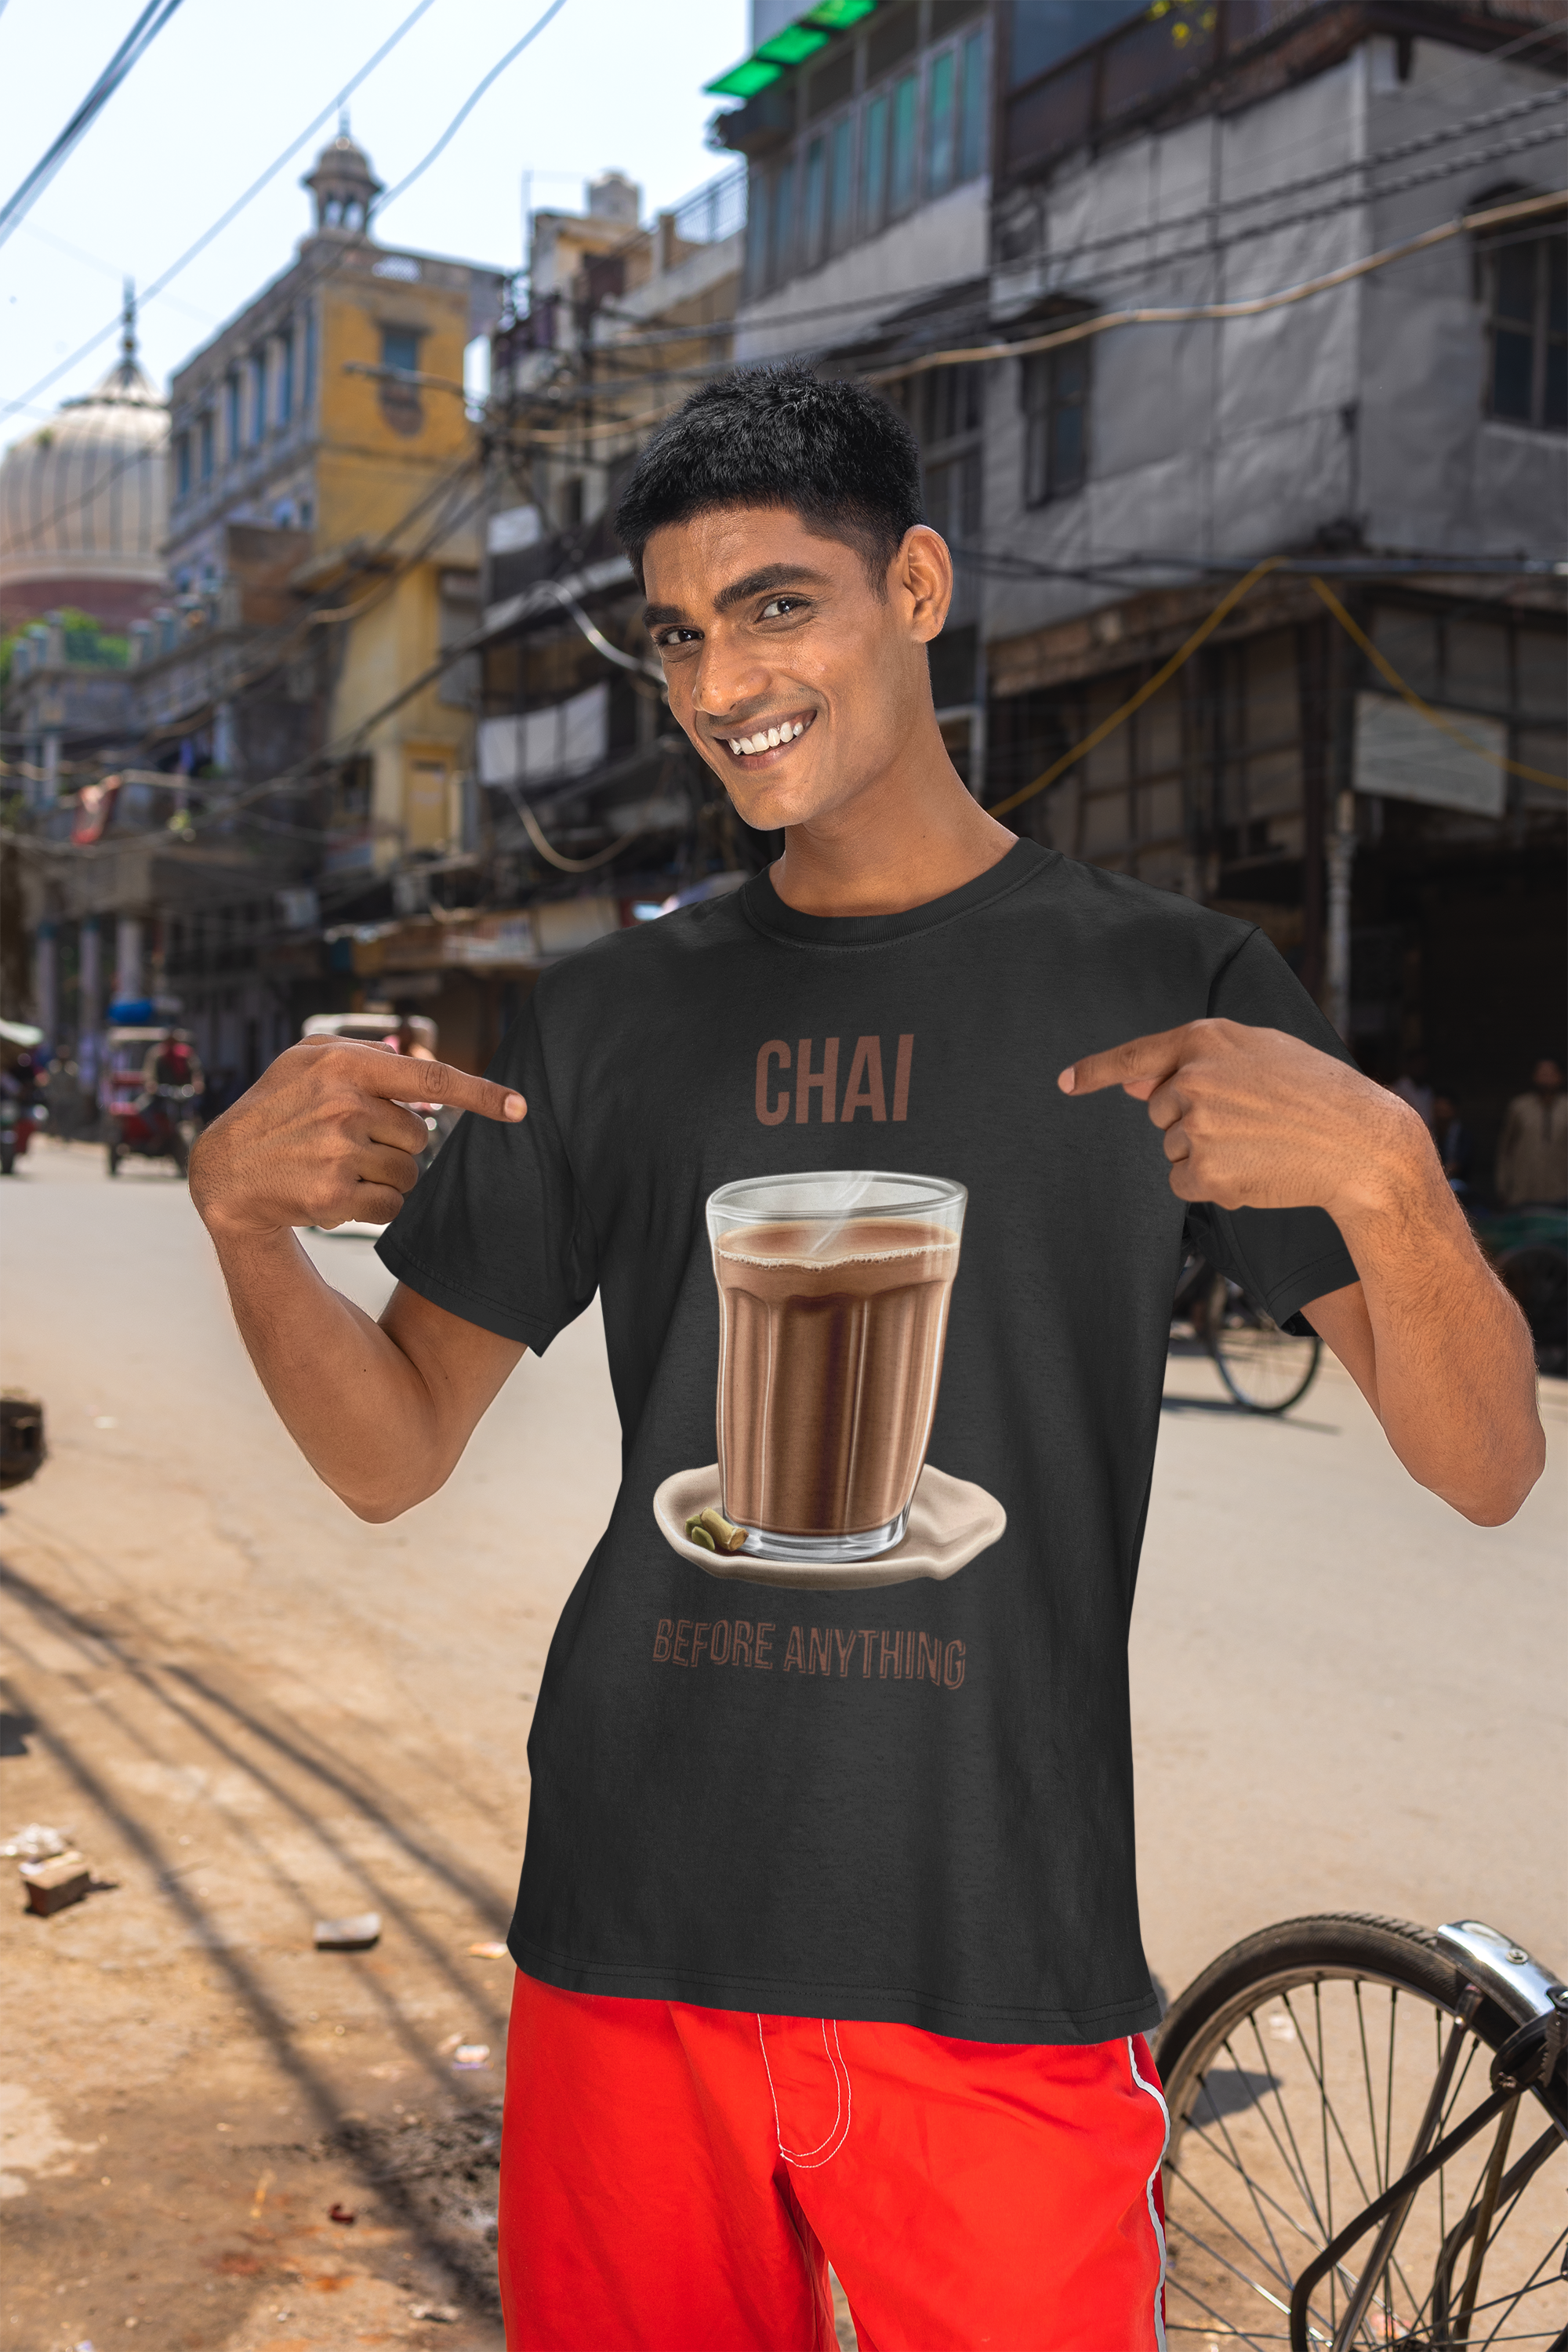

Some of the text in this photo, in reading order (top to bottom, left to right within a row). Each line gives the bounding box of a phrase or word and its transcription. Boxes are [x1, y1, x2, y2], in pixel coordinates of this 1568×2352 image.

[755, 1033, 915, 1127] CHAI
[652, 1618, 967, 1690] BEFORE ANYTHING
